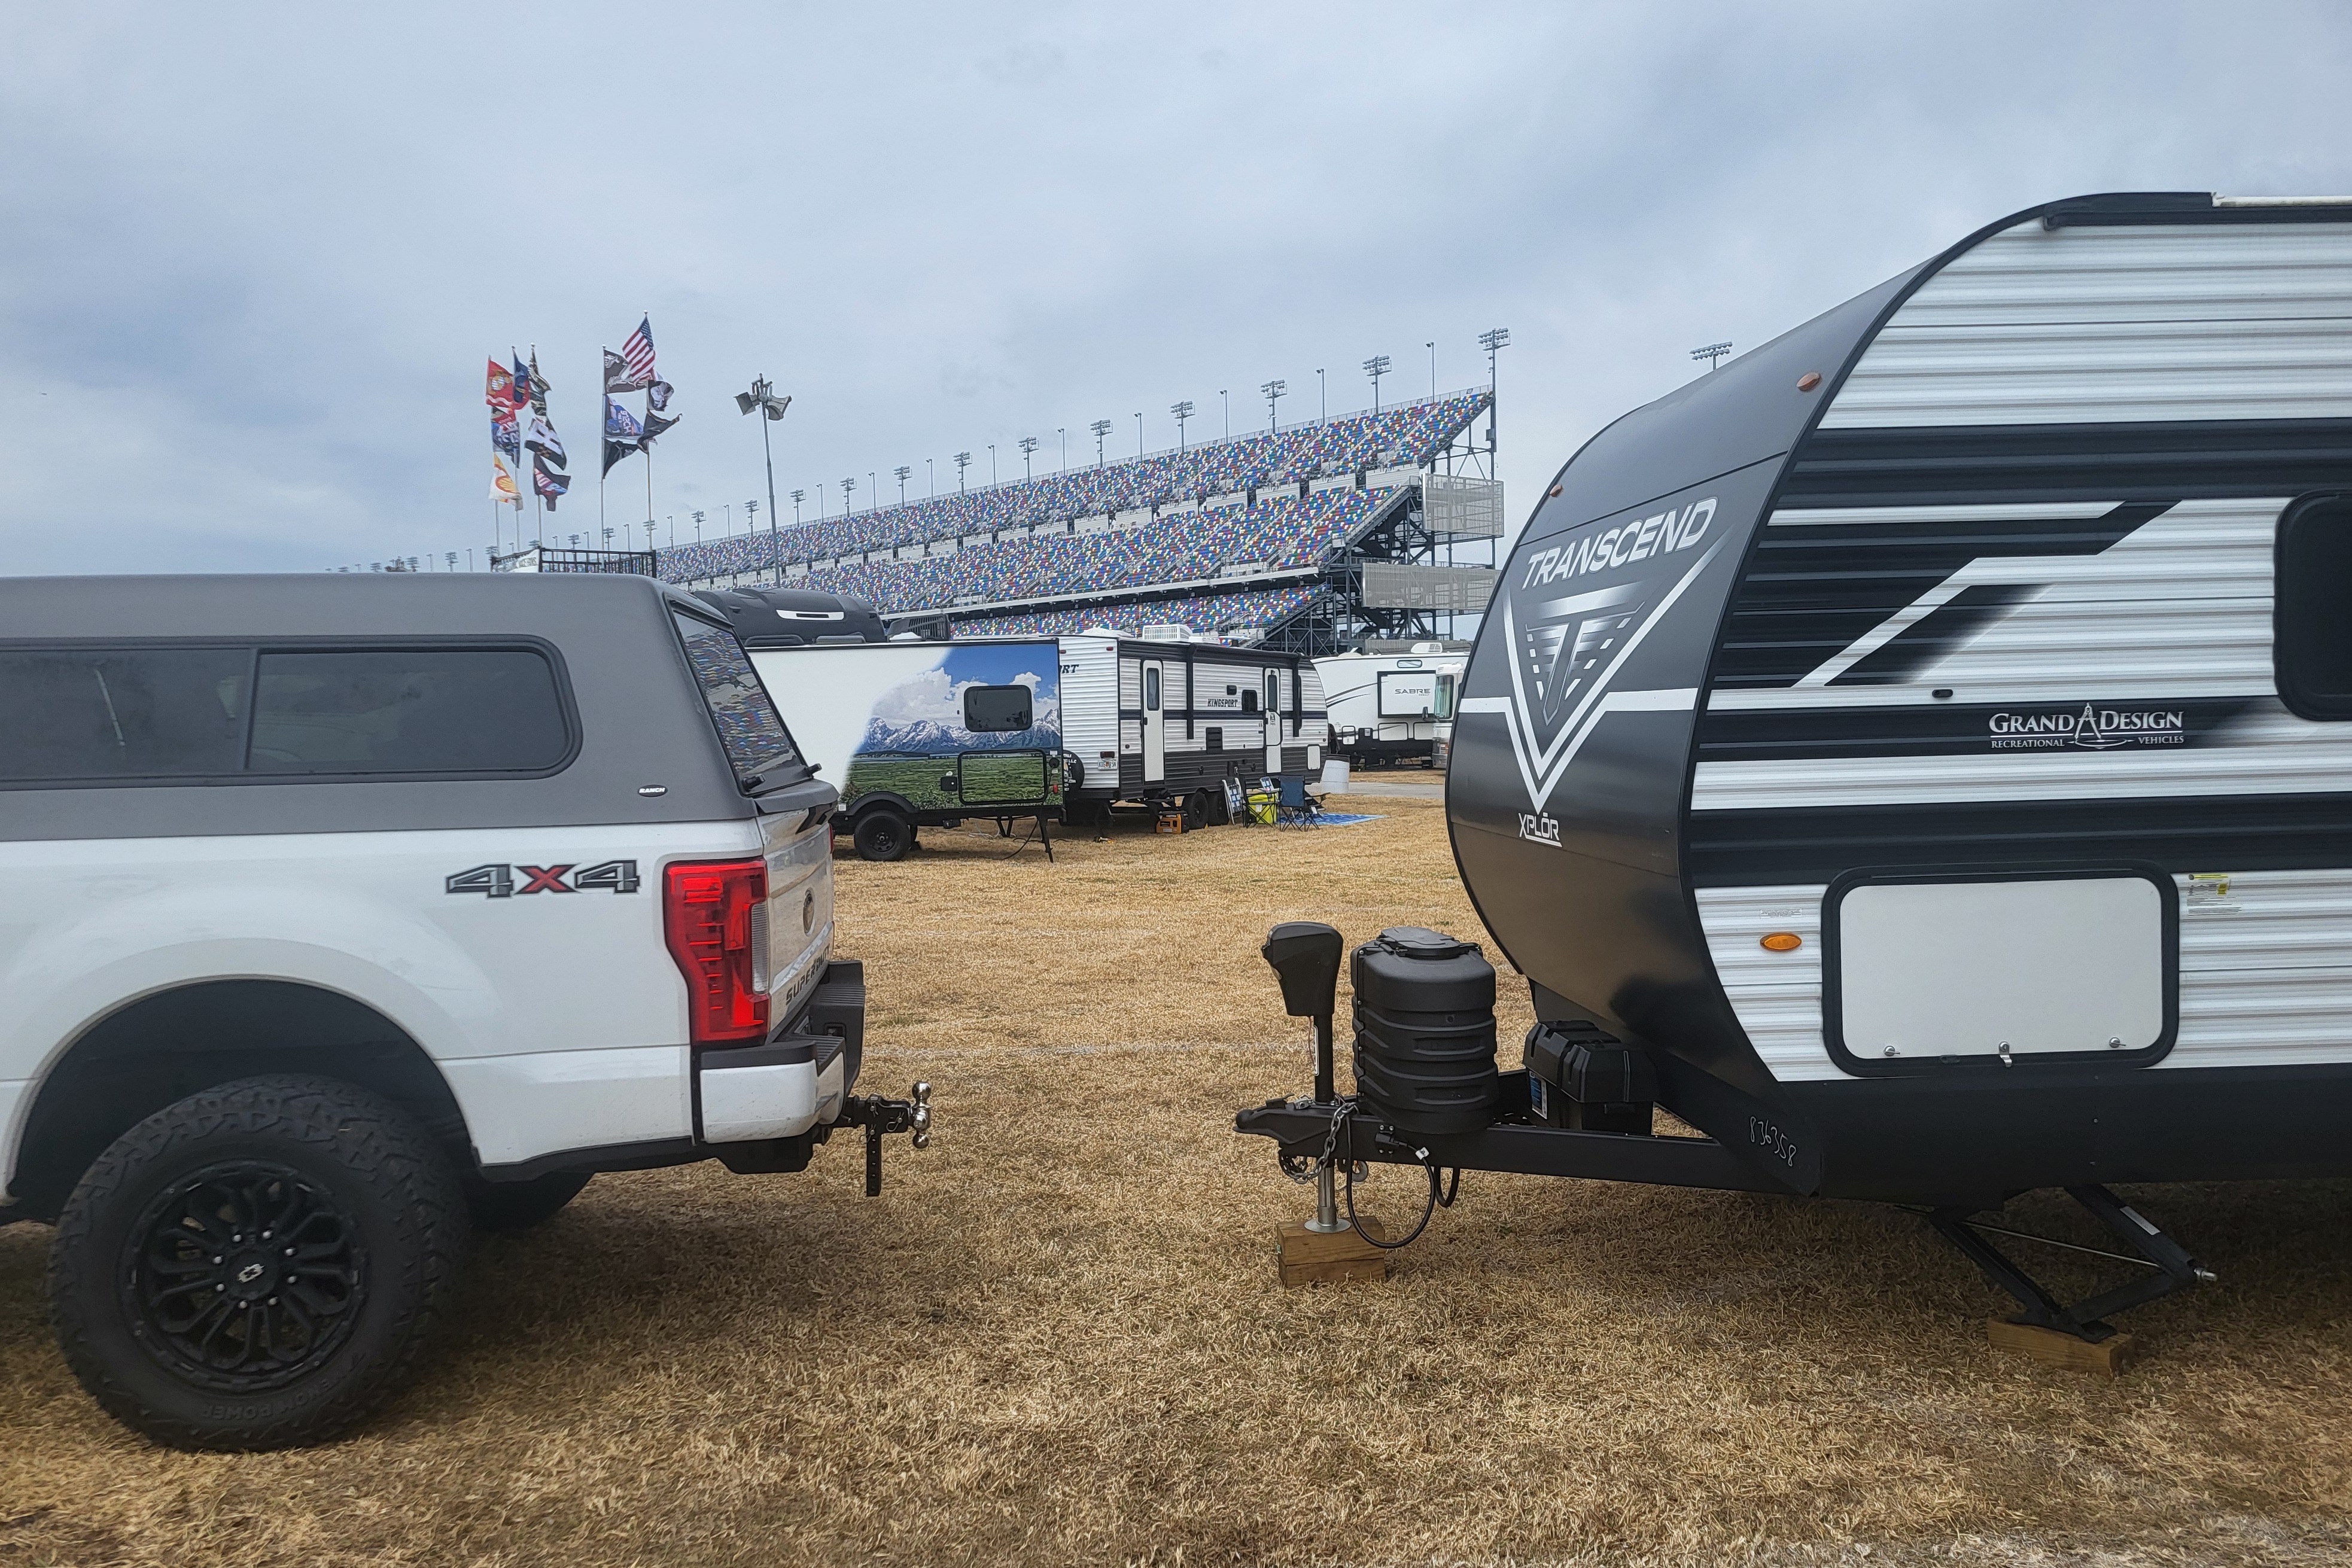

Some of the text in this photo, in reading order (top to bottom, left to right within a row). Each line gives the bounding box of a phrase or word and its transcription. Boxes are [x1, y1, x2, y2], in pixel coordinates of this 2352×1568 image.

[1521, 496, 1718, 590] TRANSCEND
[1060, 664, 1079, 674] RT
[1207, 698, 1238, 707] KINGSPORT
[1988, 710, 2184, 733] GRAND DESIGN
[1991, 735, 2184, 748] RECREATIONAL VEHICLES
[786, 958, 816, 1006] SUPER
[1750, 1116, 1797, 1167] 836358
